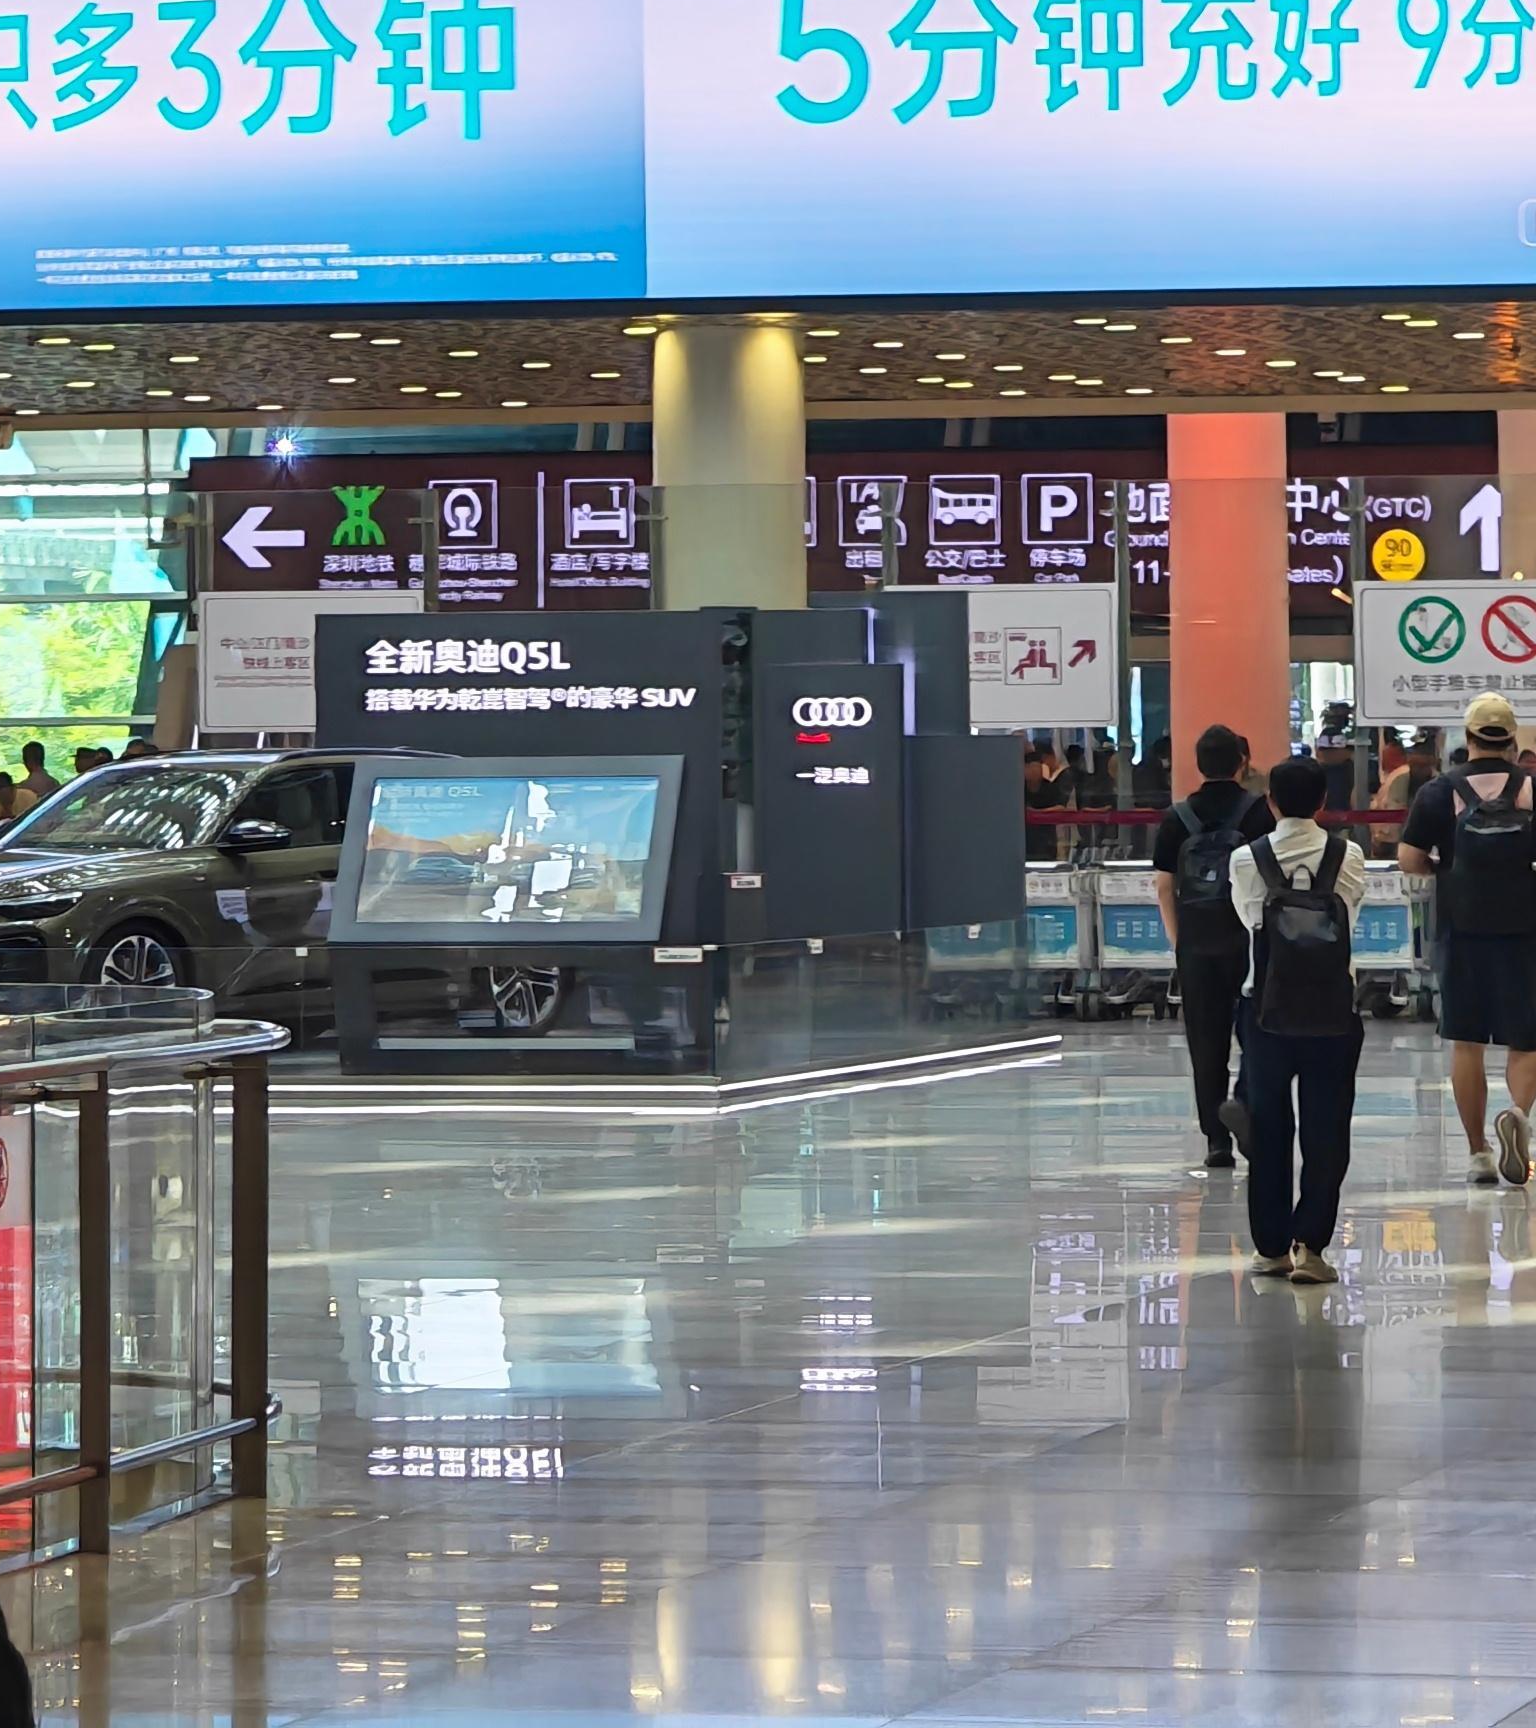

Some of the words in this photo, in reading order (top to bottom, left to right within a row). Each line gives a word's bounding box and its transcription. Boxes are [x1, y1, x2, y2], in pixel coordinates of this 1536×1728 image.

[366, 639, 571, 674] 全新奥迪Q5L
[641, 688, 696, 708] SUV
